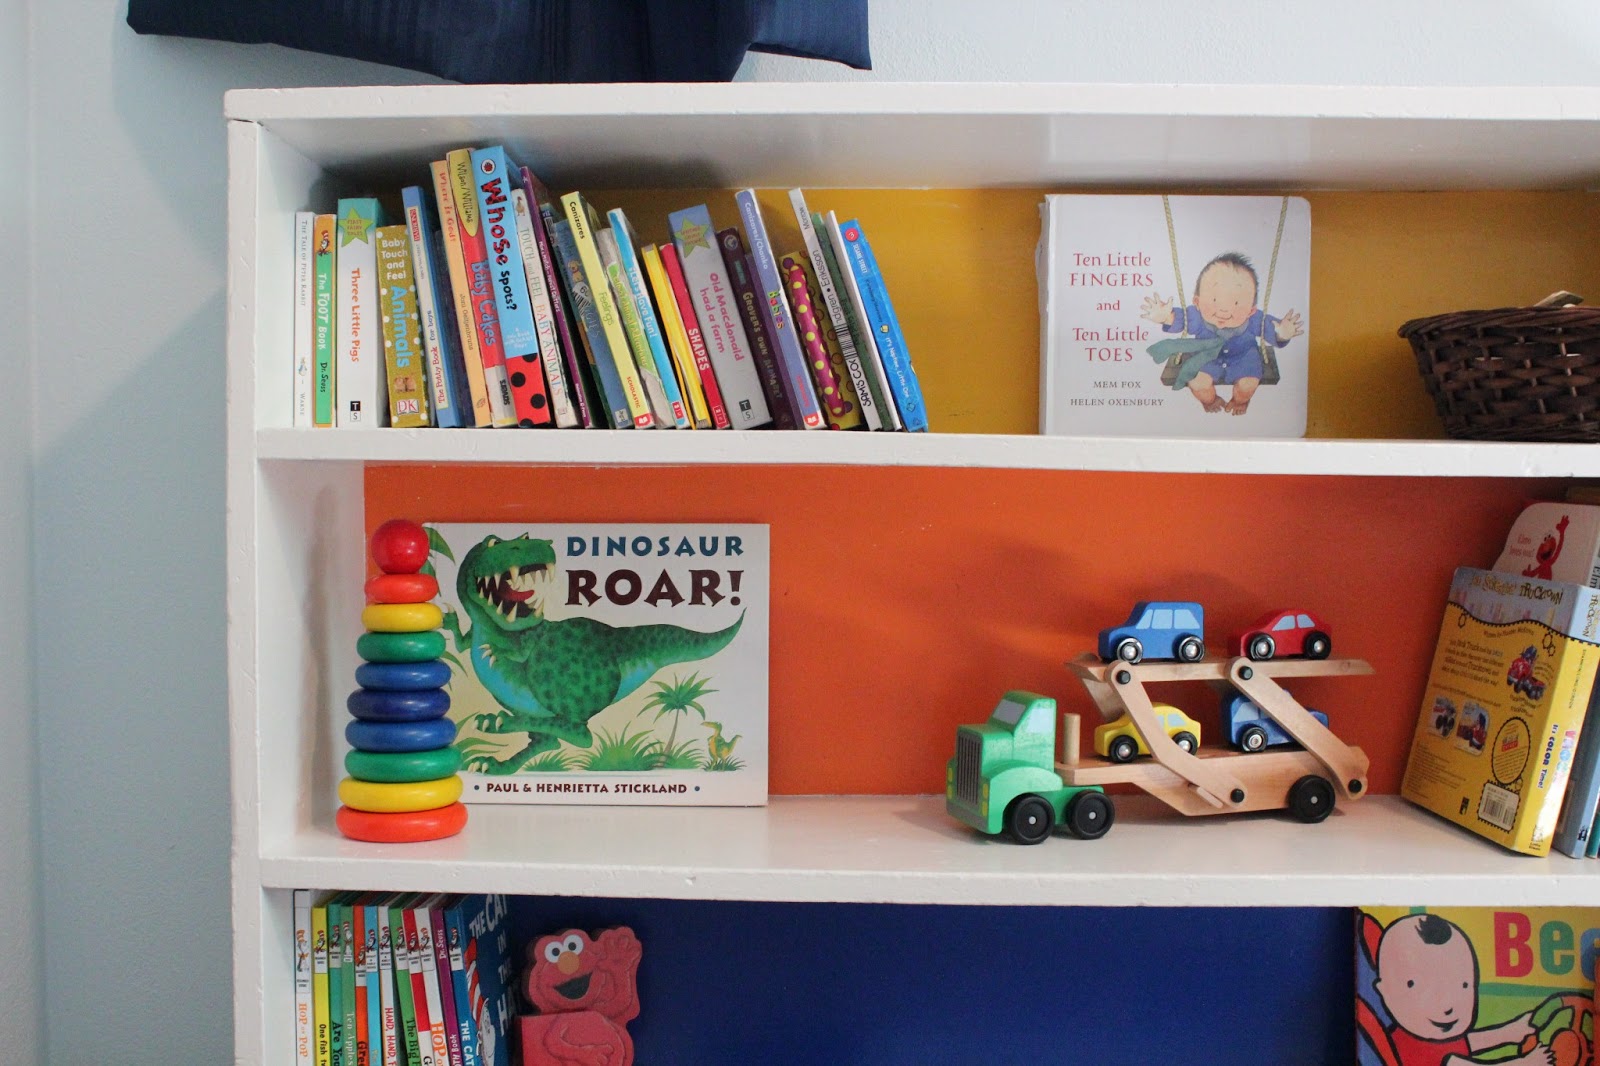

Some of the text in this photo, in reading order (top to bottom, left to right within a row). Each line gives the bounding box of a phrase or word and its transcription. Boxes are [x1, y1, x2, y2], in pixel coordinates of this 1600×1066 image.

[480, 178, 510, 266] Whose
[570, 201, 585, 240] Canizares
[381, 250, 408, 259] Touch
[382, 238, 406, 248] Baby
[386, 260, 404, 269] and
[812, 250, 831, 287] Eriksson
[1073, 252, 1151, 267] Ten Little
[387, 271, 406, 280] Feel
[1070, 273, 1153, 286] FINGERS
[318, 293, 329, 323] FOOT
[350, 268, 360, 362] Three Little Pigs
[471, 259, 499, 347] Baby Cakes
[520, 228, 532, 260] TOUCH
[530, 277, 542, 298] FEEL
[536, 304, 550, 336] BABY
[543, 341, 562, 396] ANIMALS
[599, 292, 613, 325] Feelings
[768, 289, 784, 329] Babies
[828, 294, 843, 323] ndgren
[1096, 300, 1120, 311] and
[390, 286, 414, 368] Animals
[644, 317, 658, 338] Fun!
[700, 287, 715, 311] had
[711, 324, 724, 352] farm
[710, 273, 722, 293] Old
[716, 295, 744, 361] Macdonald
[1072, 326, 1149, 341] Ten Little
[688, 328, 709, 371] SHAPES
[1085, 347, 1133, 362] TOES
[627, 376, 640, 408] SCHOLASTIC
[398, 400, 417, 412] DK
[567, 536, 744, 557] DINOSAUR
[565, 568, 744, 607] ROAR!
[1590, 566, 1600, 588] Elm
[1543, 736, 1555, 766] COLOR
[486, 783, 687, 794] PAUL & HENRIETTA STICKLAND
[1538, 769, 1547, 788] Time!
[469, 894, 508, 940] THE CAT
[332, 1021, 343, 1043] Are
[385, 1008, 394, 1031] HAND,
[407, 1018, 415, 1037] The
[346, 1034, 355, 1066] Apples
[387, 1036, 396, 1059] HAND,
[408, 1040, 419, 1058] Big
[431, 1021, 447, 1056] HOP
[450, 1035, 459, 1052] Book
[461, 1021, 474, 1066] THE CAT
